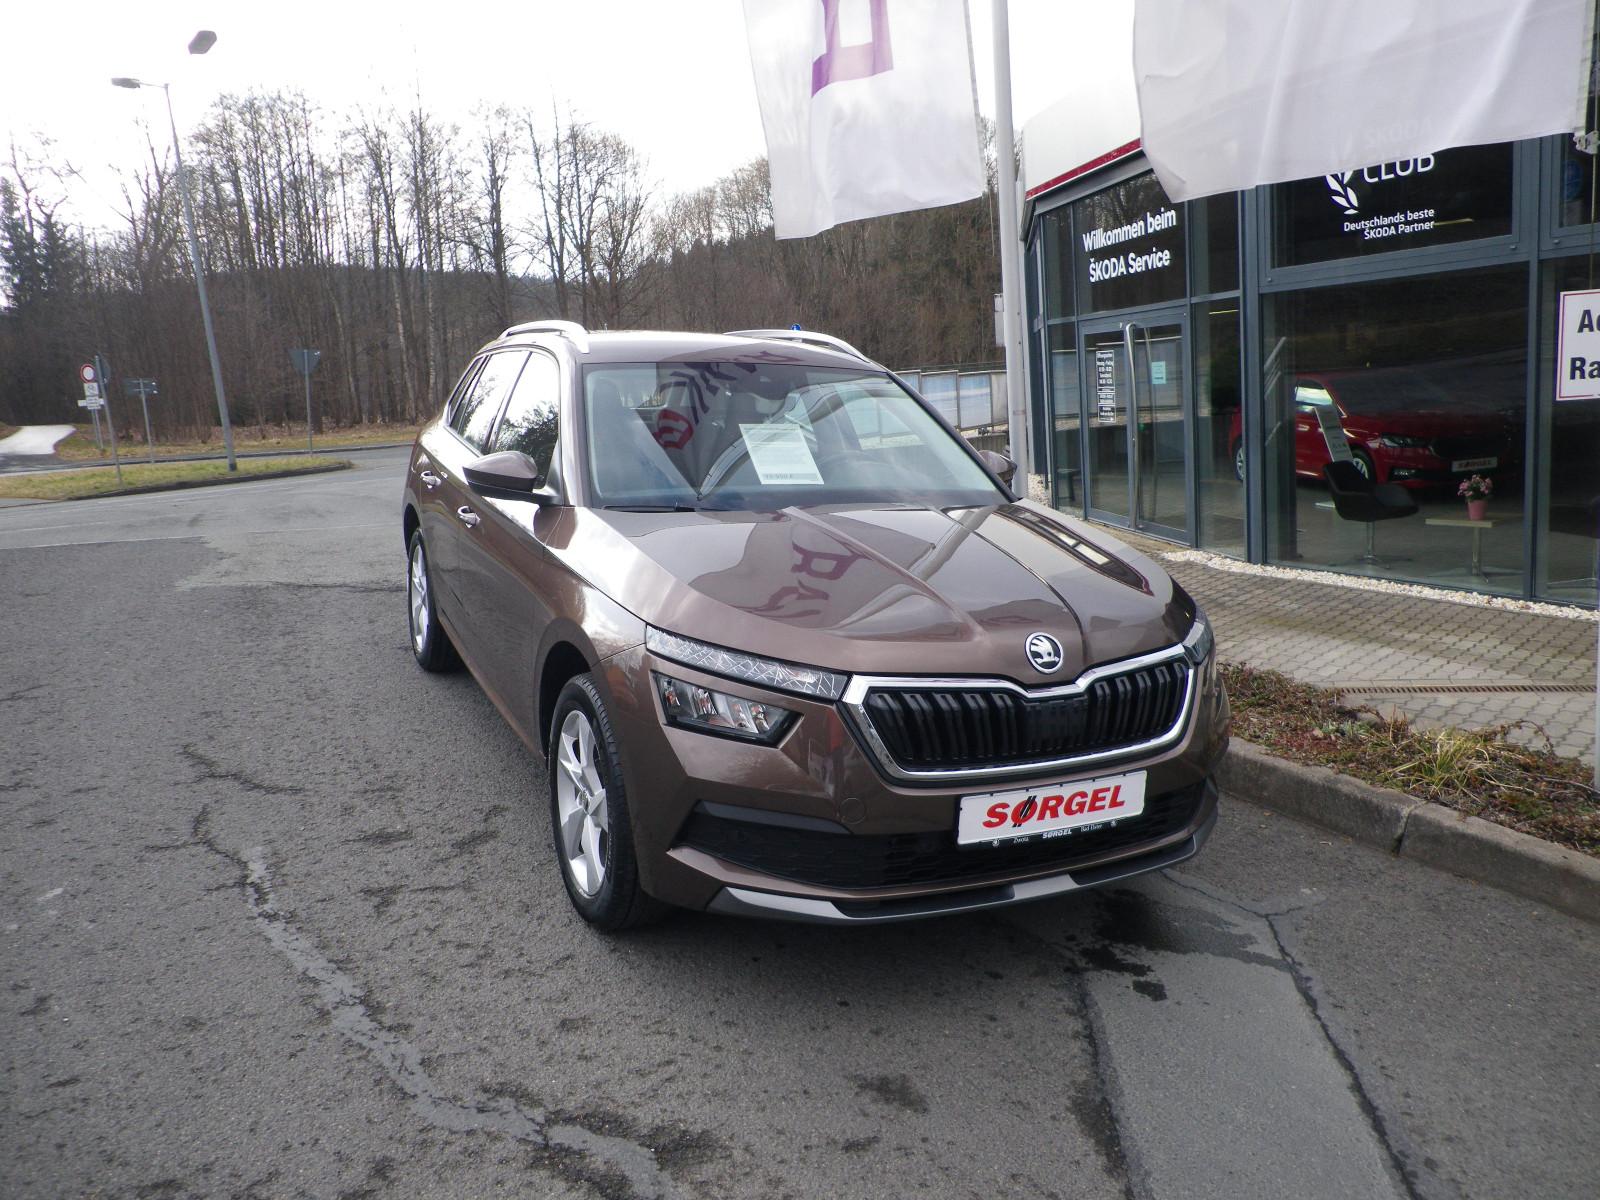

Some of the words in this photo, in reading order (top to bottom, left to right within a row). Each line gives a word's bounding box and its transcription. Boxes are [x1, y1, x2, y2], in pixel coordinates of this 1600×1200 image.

[1082, 219, 1146, 253] Willkommen
[1146, 206, 1177, 234] beim
[1343, 212, 1405, 232] Deutschlands
[1406, 208, 1435, 221] beste
[1363, 226, 1396, 240] ŠKODA
[1398, 220, 1435, 234] Partner
[1089, 255, 1127, 283] ŠKODA
[1127, 246, 1171, 274] Service
